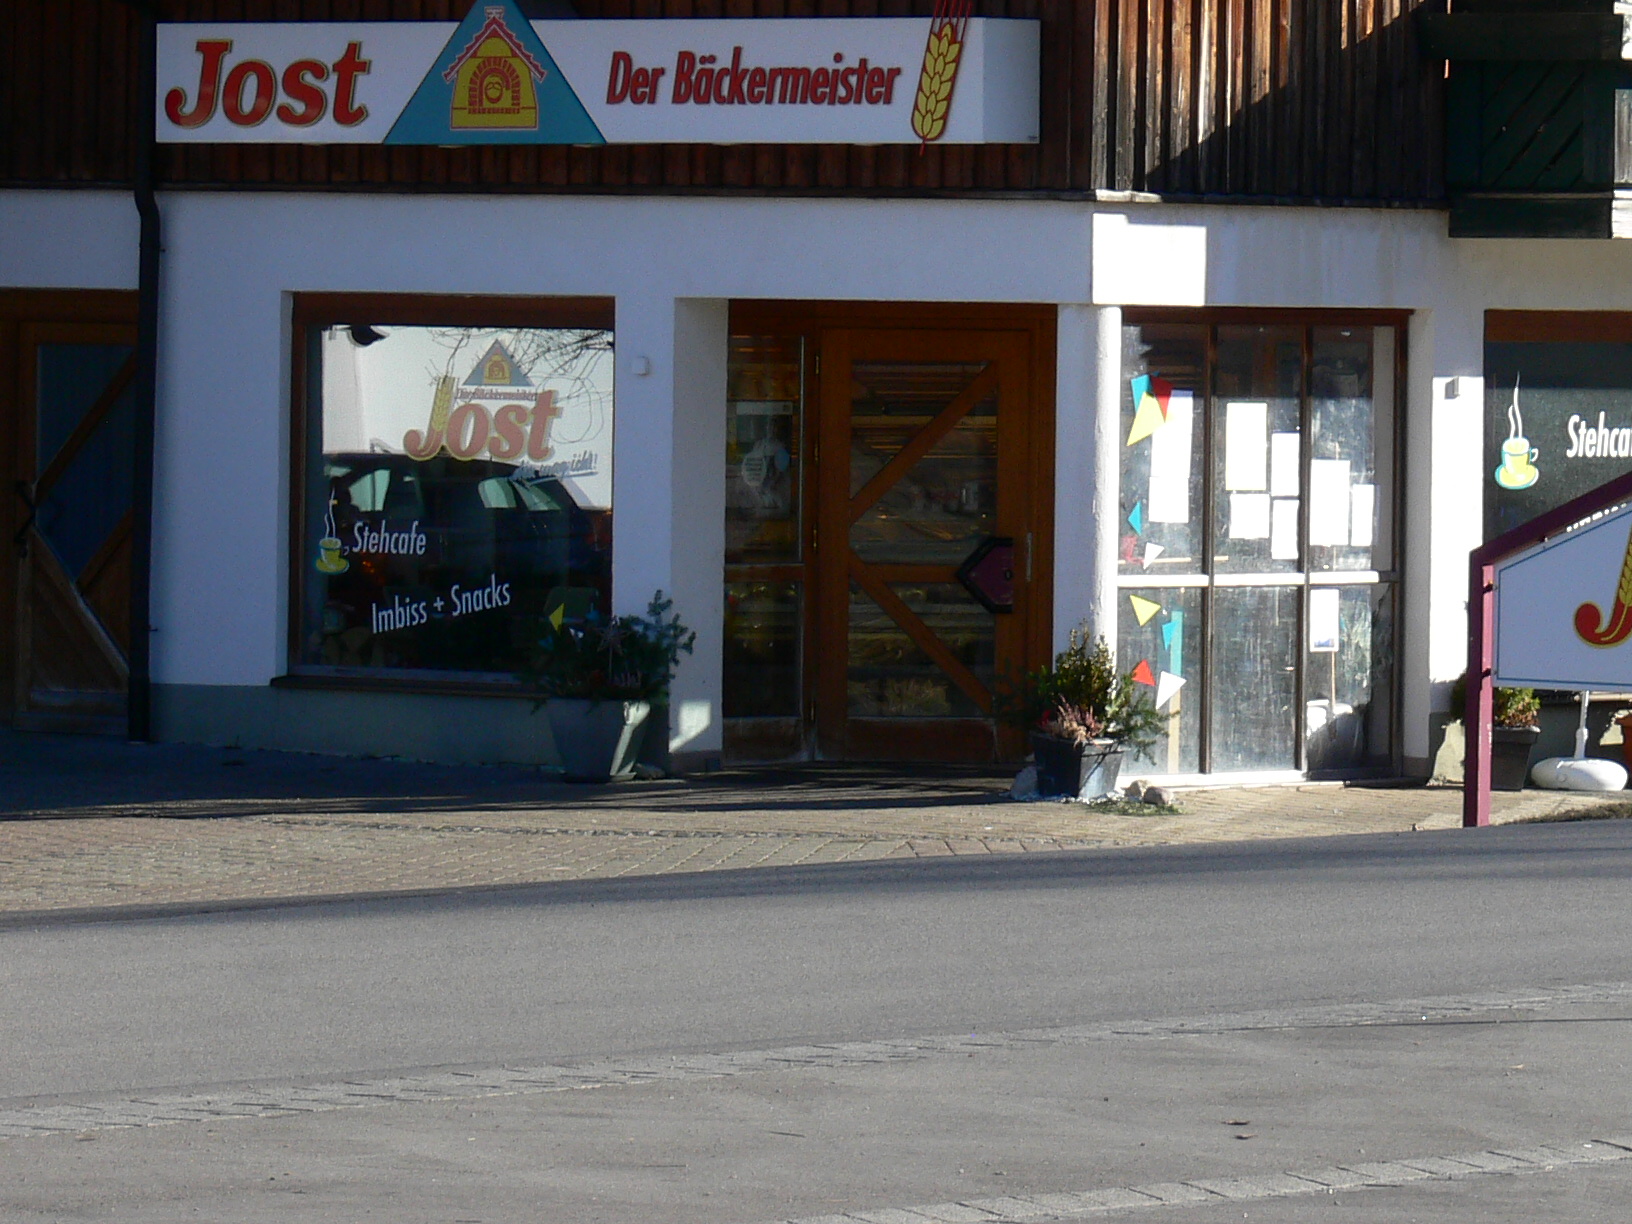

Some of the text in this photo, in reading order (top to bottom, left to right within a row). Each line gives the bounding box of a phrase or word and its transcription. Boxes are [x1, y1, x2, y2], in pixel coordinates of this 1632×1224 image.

[165, 39, 372, 129] Jost
[606, 45, 901, 106] Der Bäckermeister
[403, 376, 563, 461] Jost
[352, 519, 427, 556] Stehcafe
[372, 573, 512, 635] Imbiss + Snacks
